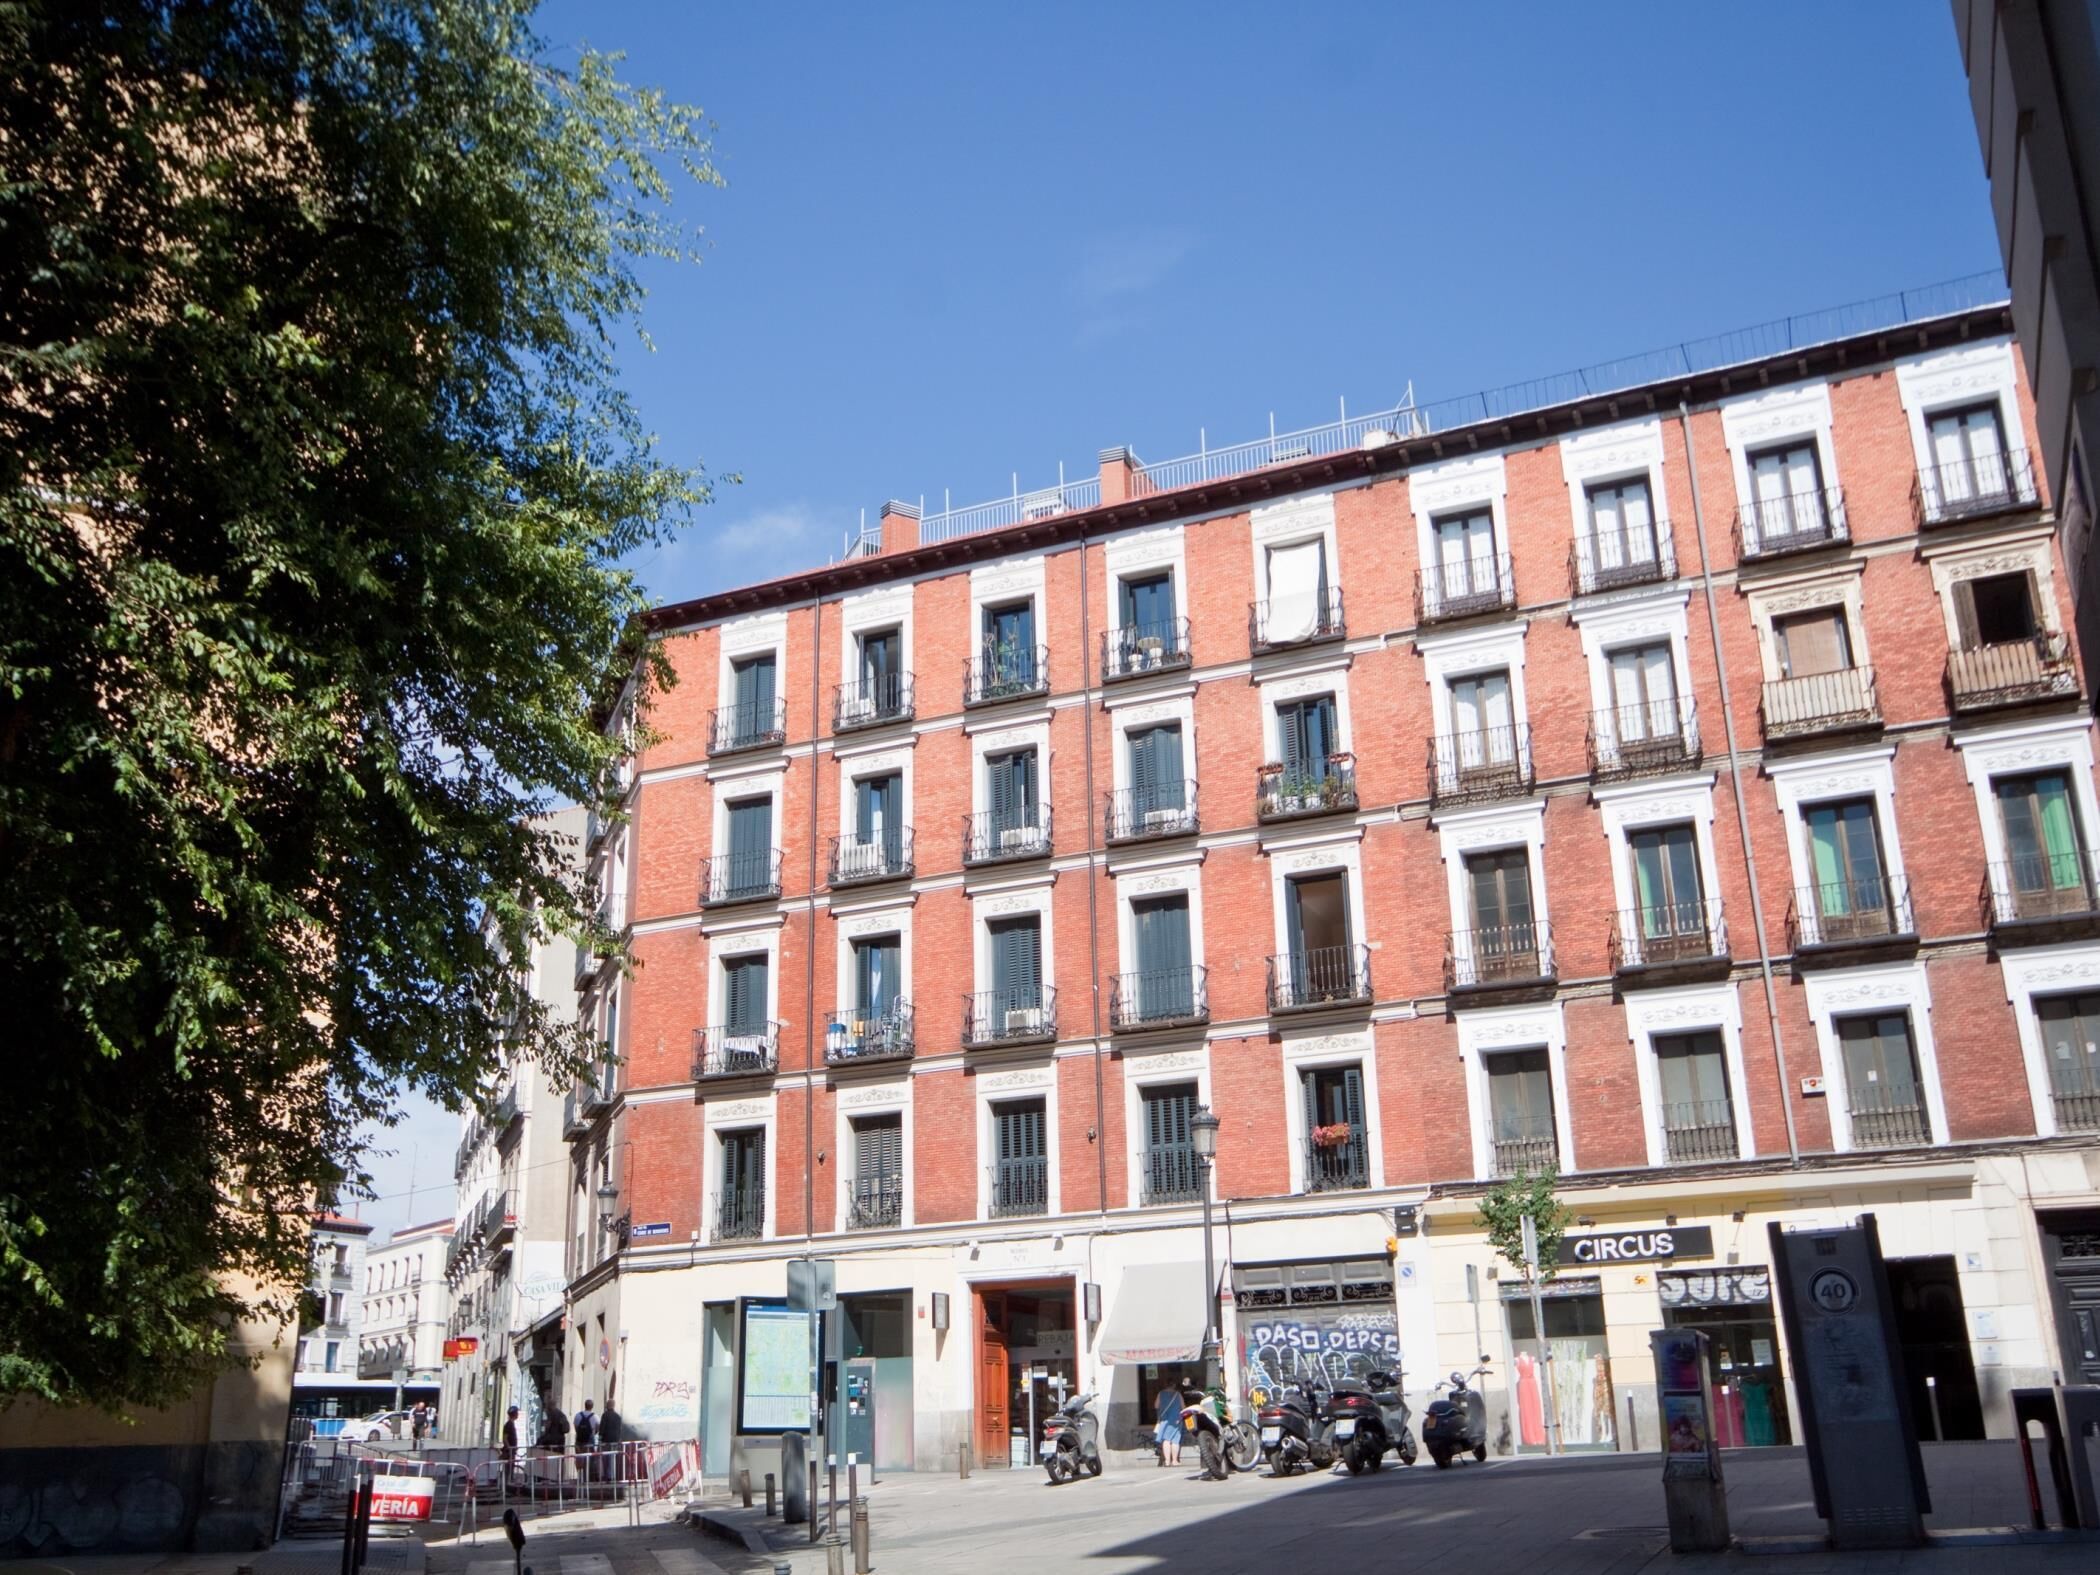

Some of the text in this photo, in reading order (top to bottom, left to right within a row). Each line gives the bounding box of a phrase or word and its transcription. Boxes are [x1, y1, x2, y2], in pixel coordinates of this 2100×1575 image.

[1574, 1232, 1675, 1261] CIRCUS
[1820, 1283, 1846, 1299] 40
[370, 1495, 419, 1516] VERÍA
